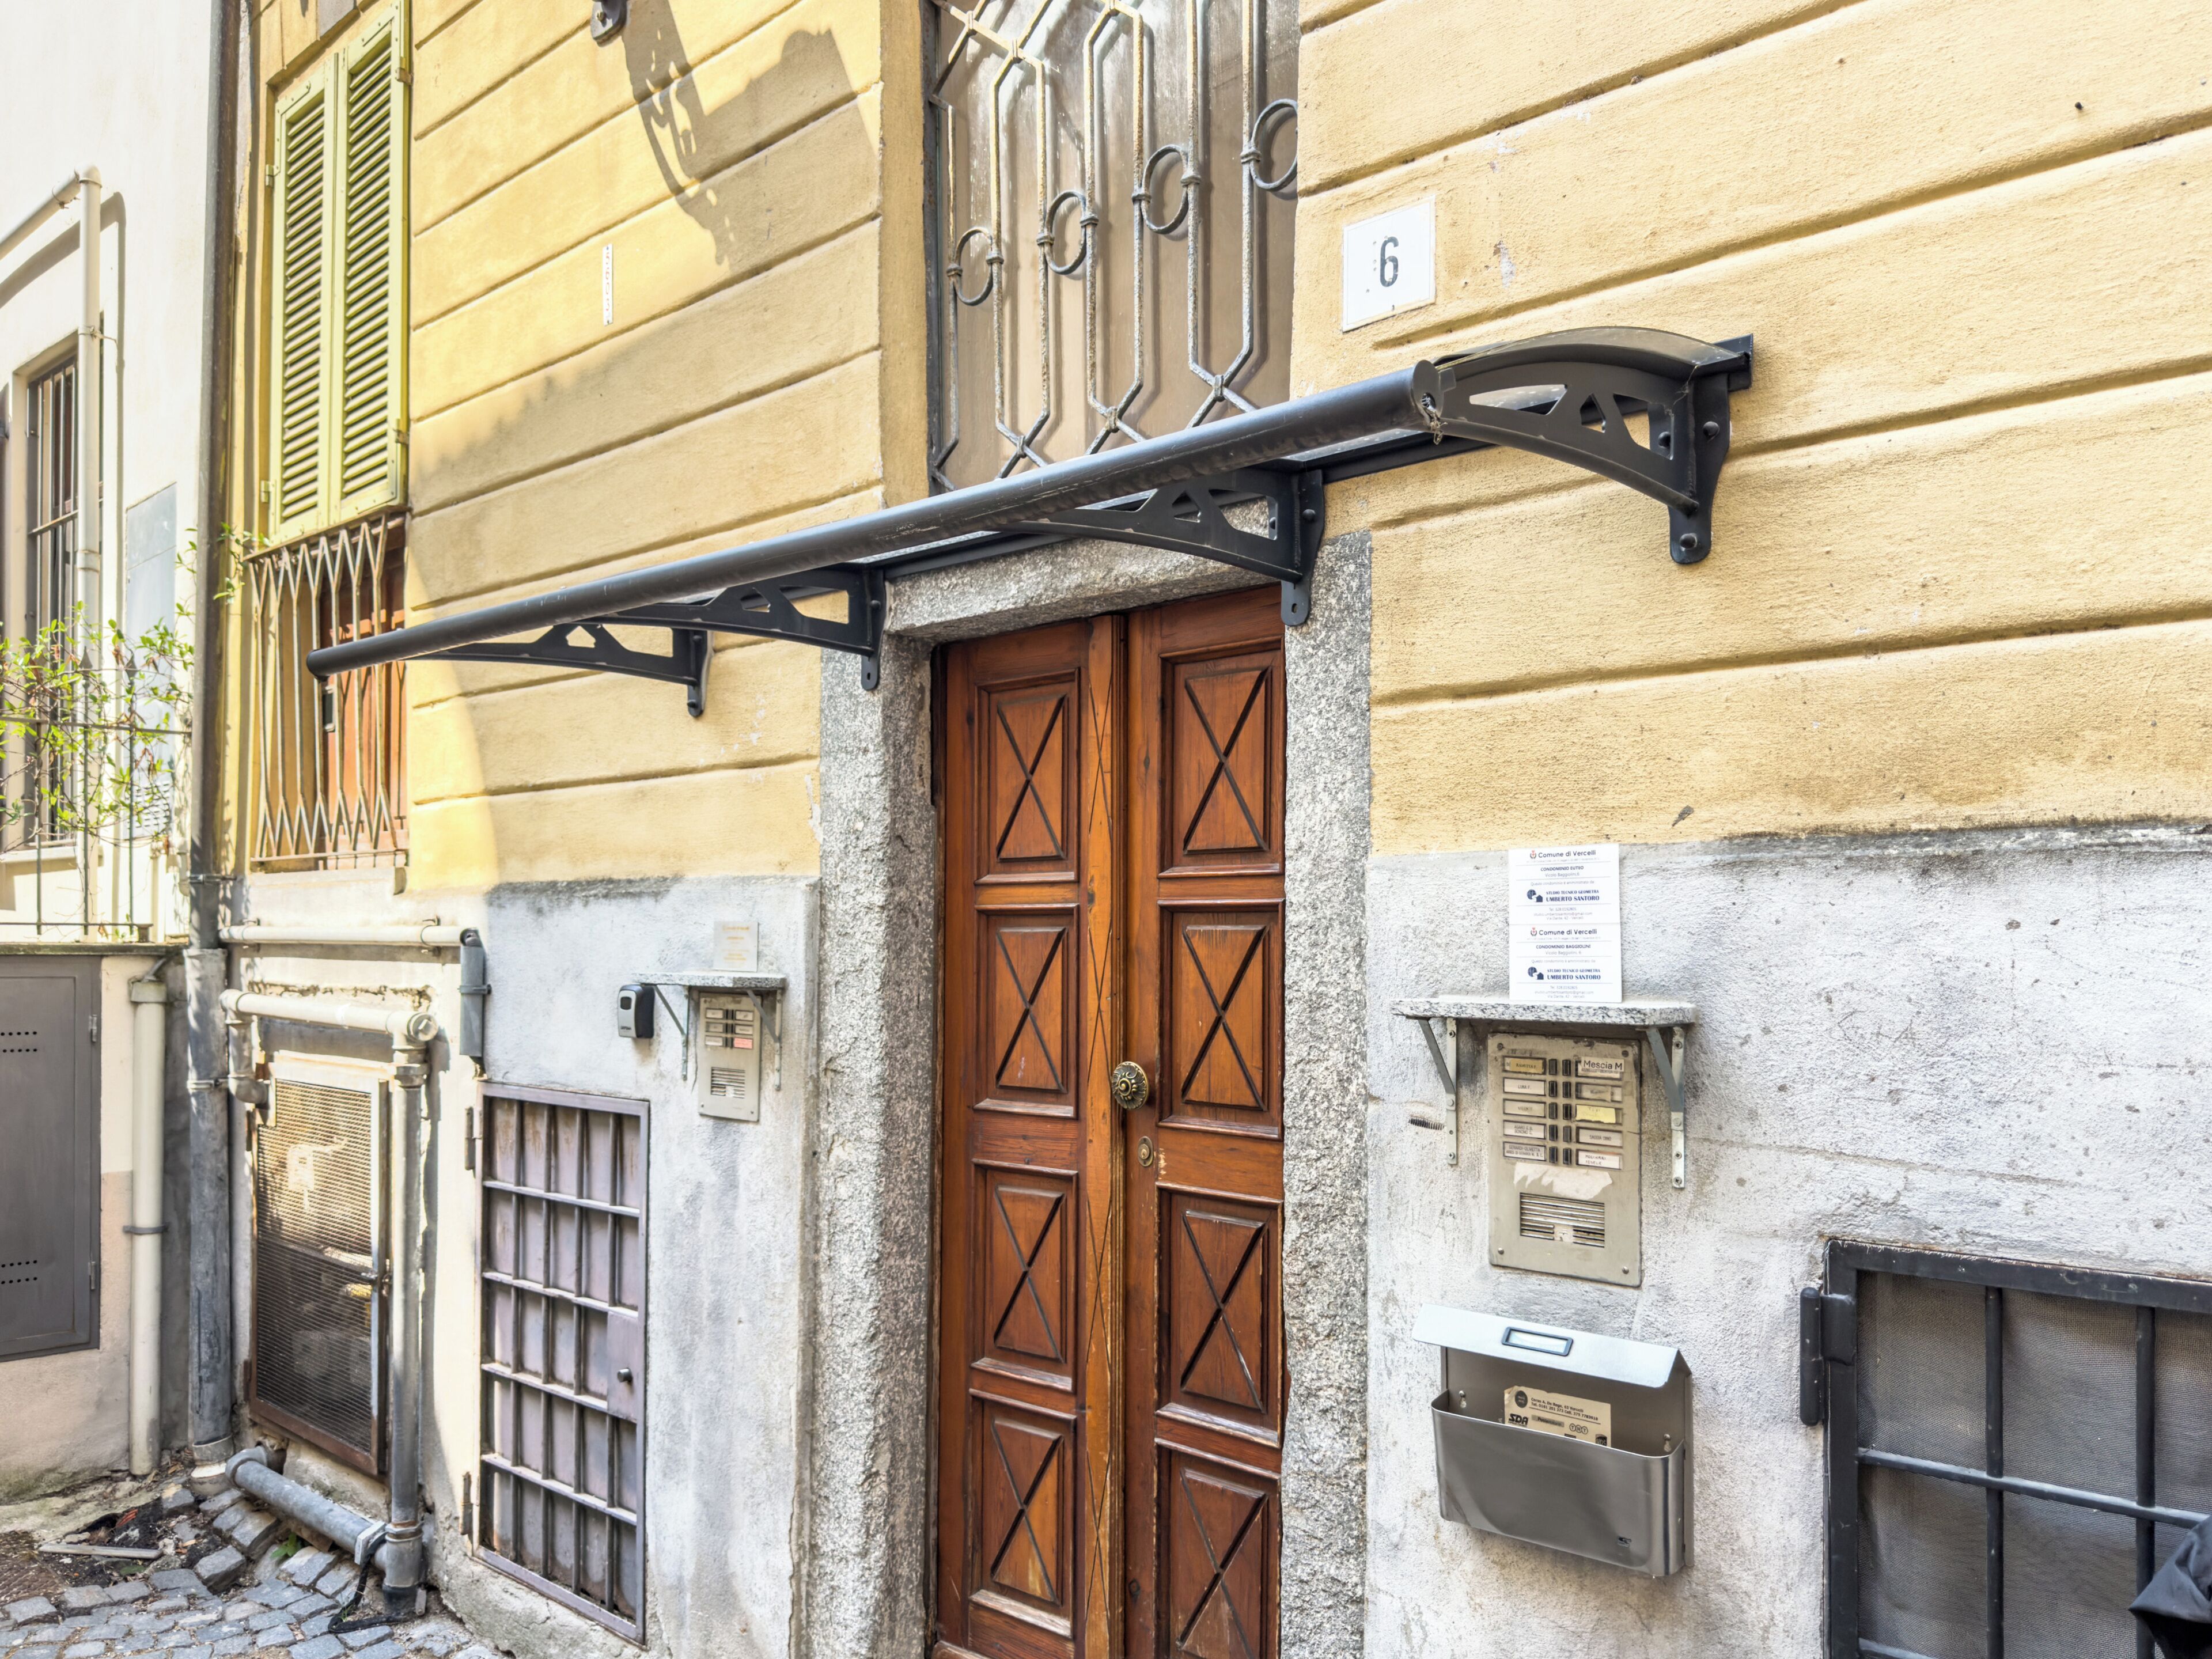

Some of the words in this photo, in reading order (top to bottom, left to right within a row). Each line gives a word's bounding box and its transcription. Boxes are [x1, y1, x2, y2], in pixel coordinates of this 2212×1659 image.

[1380, 236, 1399, 287] 6
[1584, 1060, 1612, 1069] Mescia
[1509, 1413, 1528, 1425] SDA
